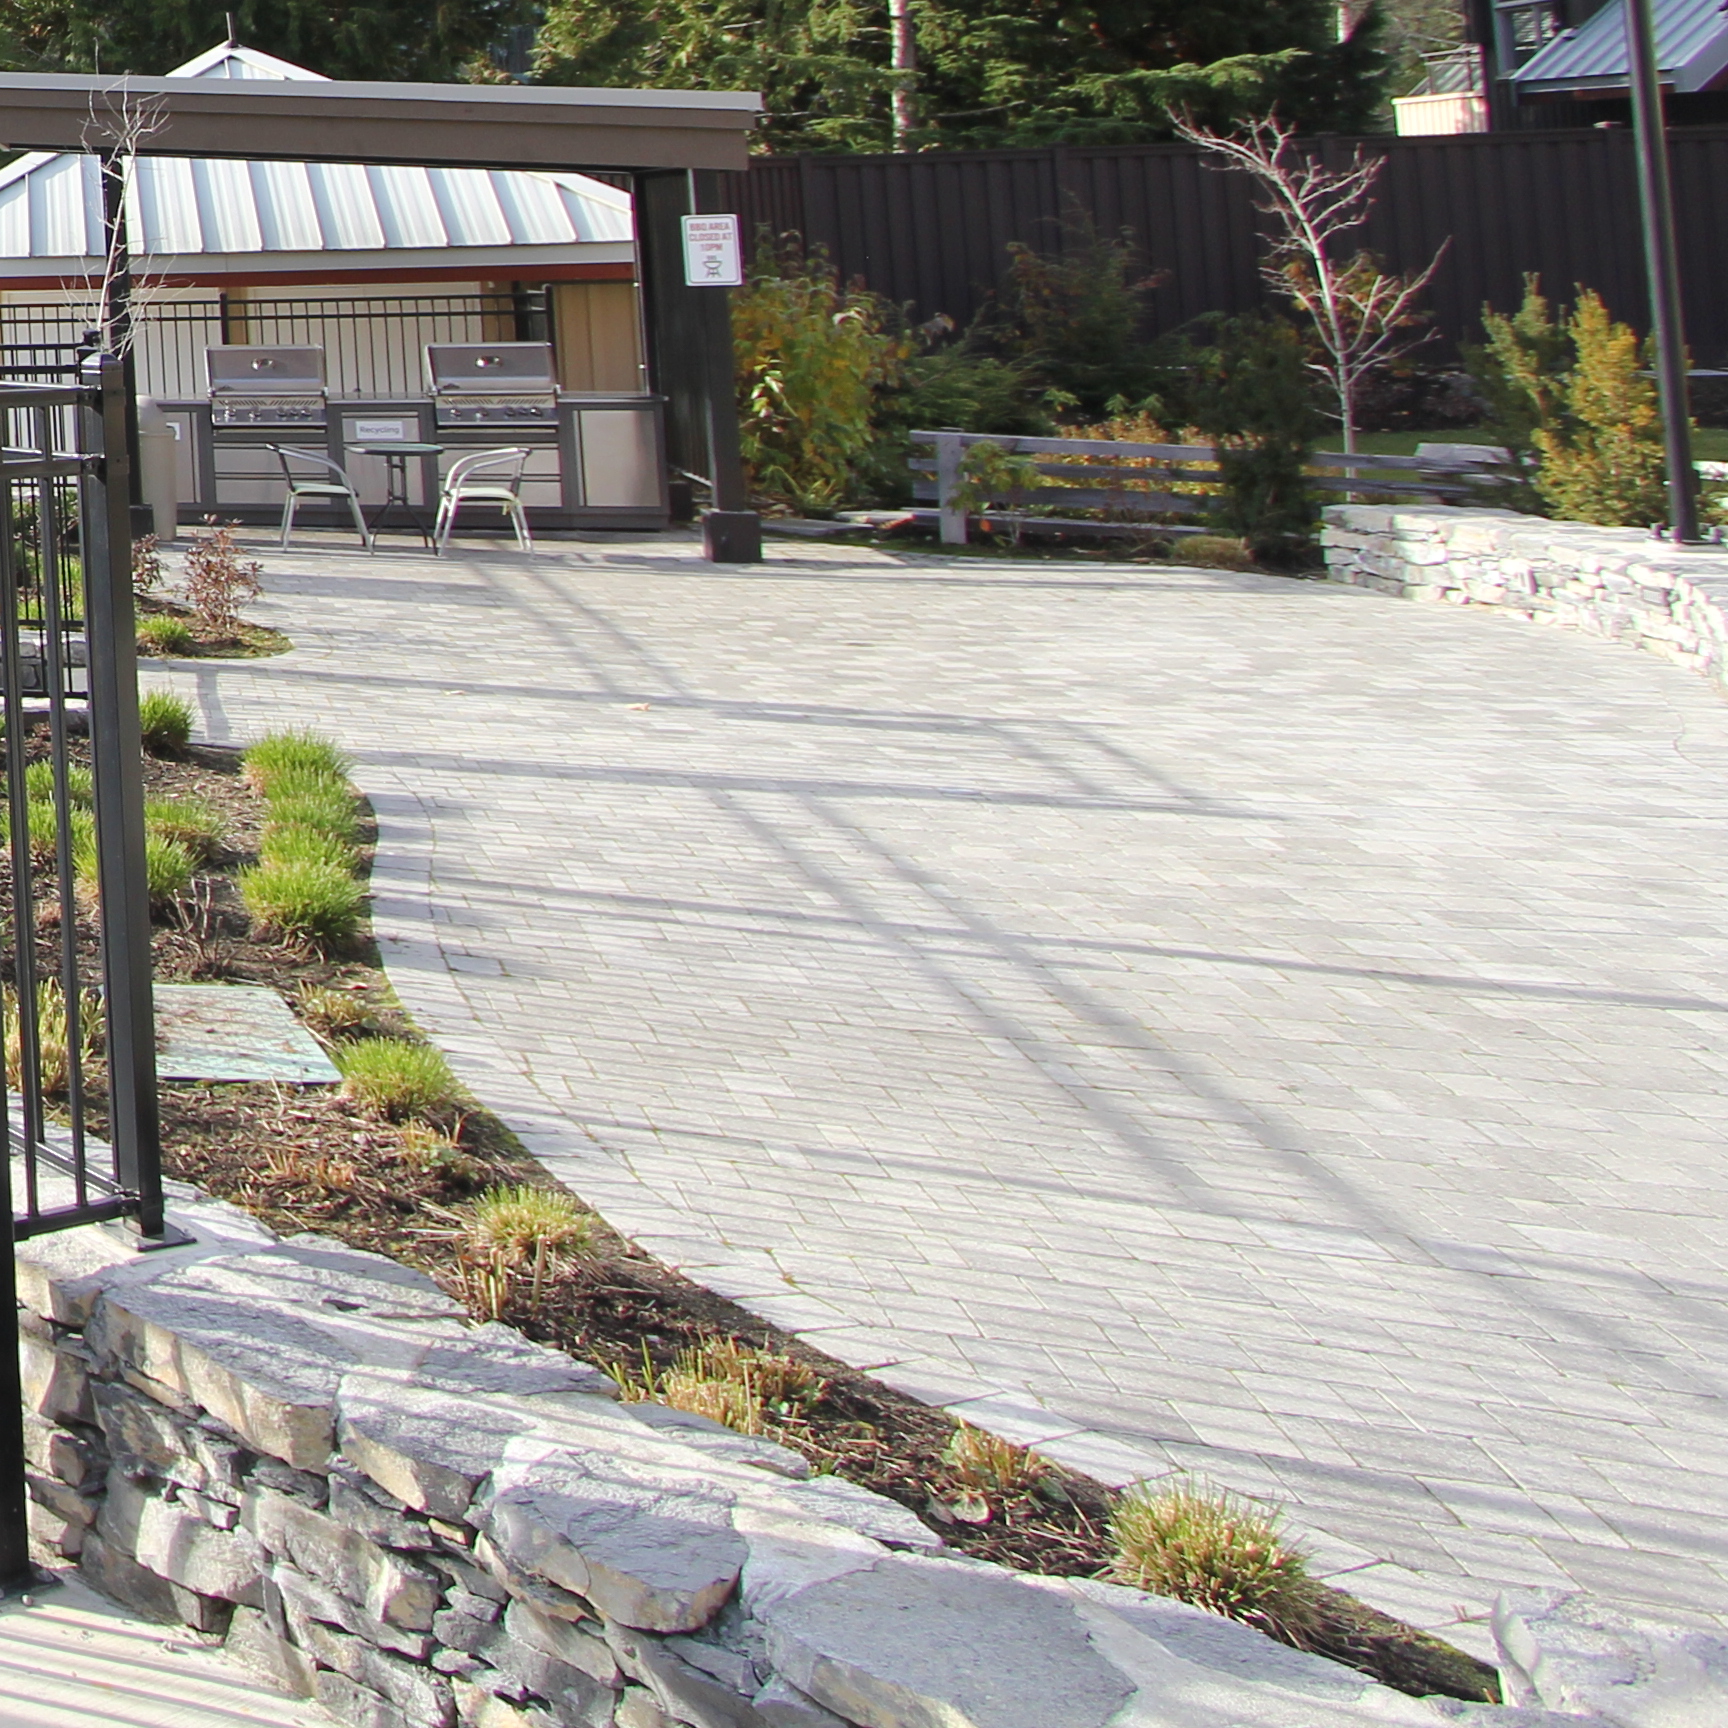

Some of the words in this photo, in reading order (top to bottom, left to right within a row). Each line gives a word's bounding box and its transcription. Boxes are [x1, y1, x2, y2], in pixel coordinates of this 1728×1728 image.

[689, 223, 707, 231] BBQ
[709, 222, 730, 231] AREA
[689, 233, 721, 242] CLOSED
[722, 232, 733, 241] AT
[359, 426, 400, 435] Recycling
